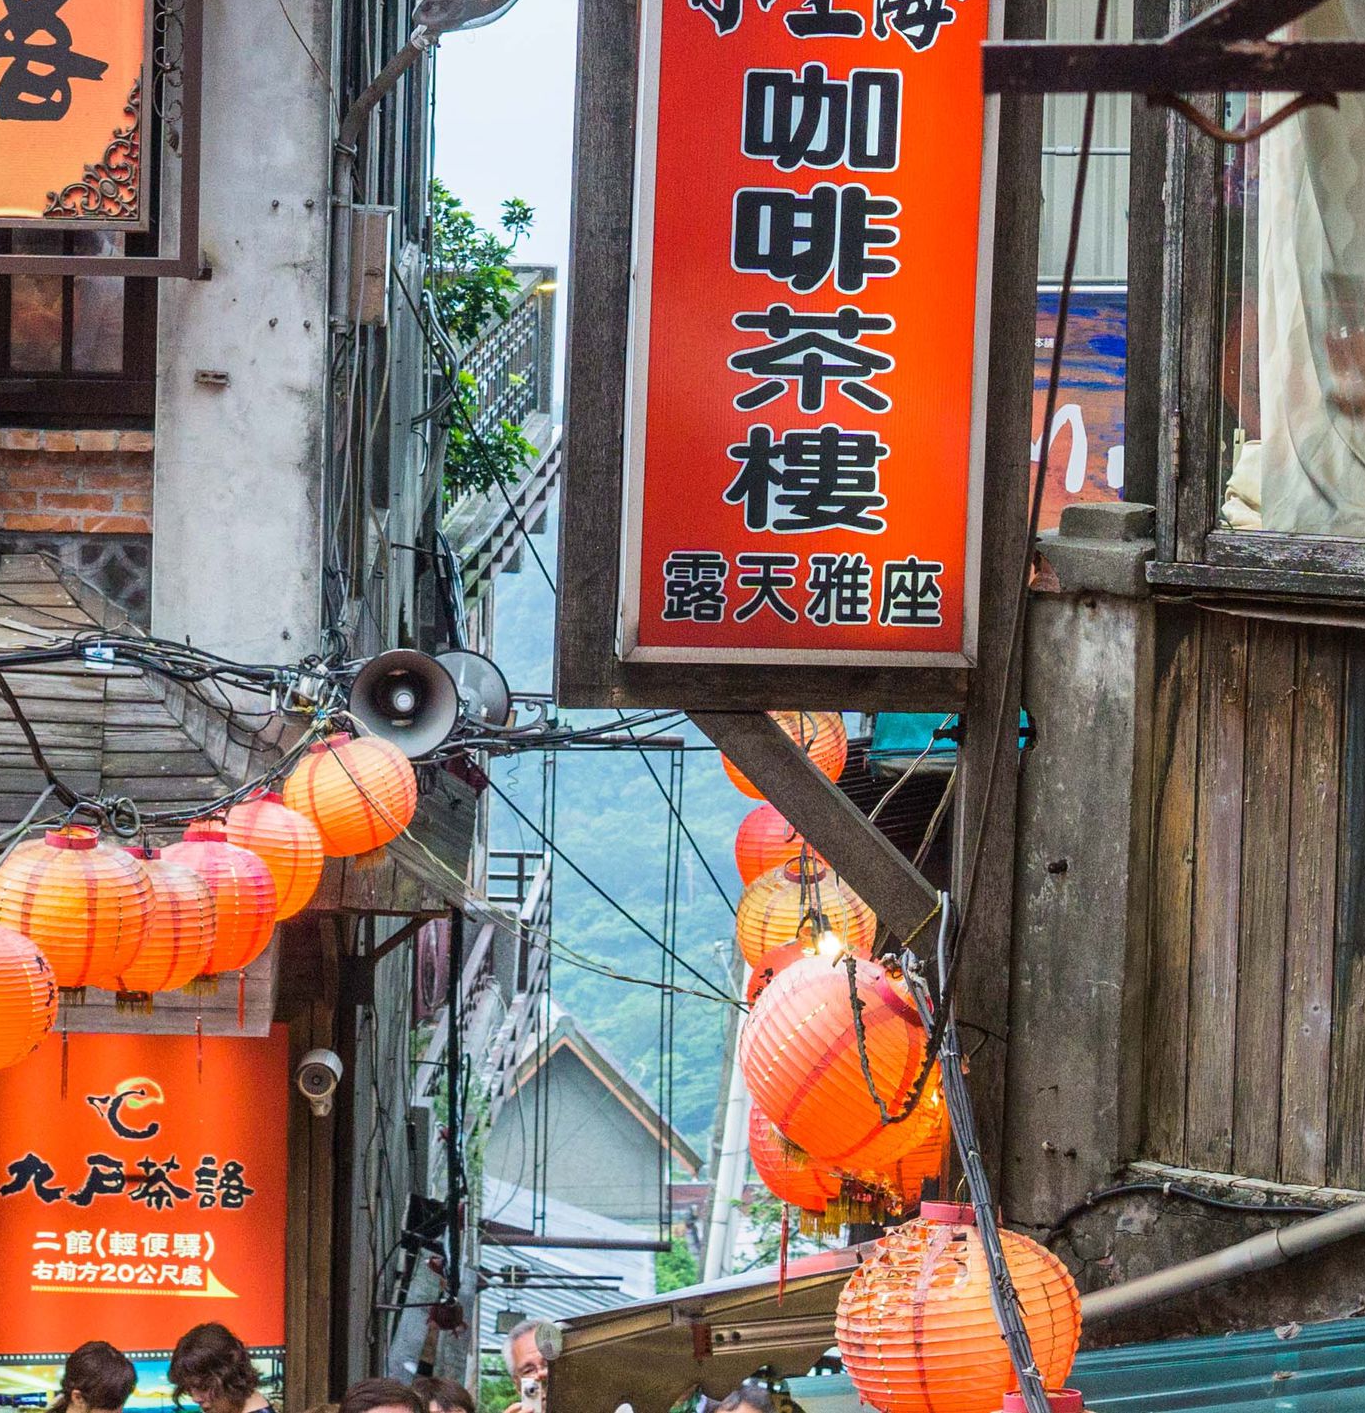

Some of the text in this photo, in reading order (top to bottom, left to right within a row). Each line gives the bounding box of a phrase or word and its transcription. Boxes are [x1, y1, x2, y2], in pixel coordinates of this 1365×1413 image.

[722, 60, 905, 536] 咖啡茶樓
[662, 550, 944, 628] 露天雅座
[31, 1260, 205, 1287] 右前方20公尺處
